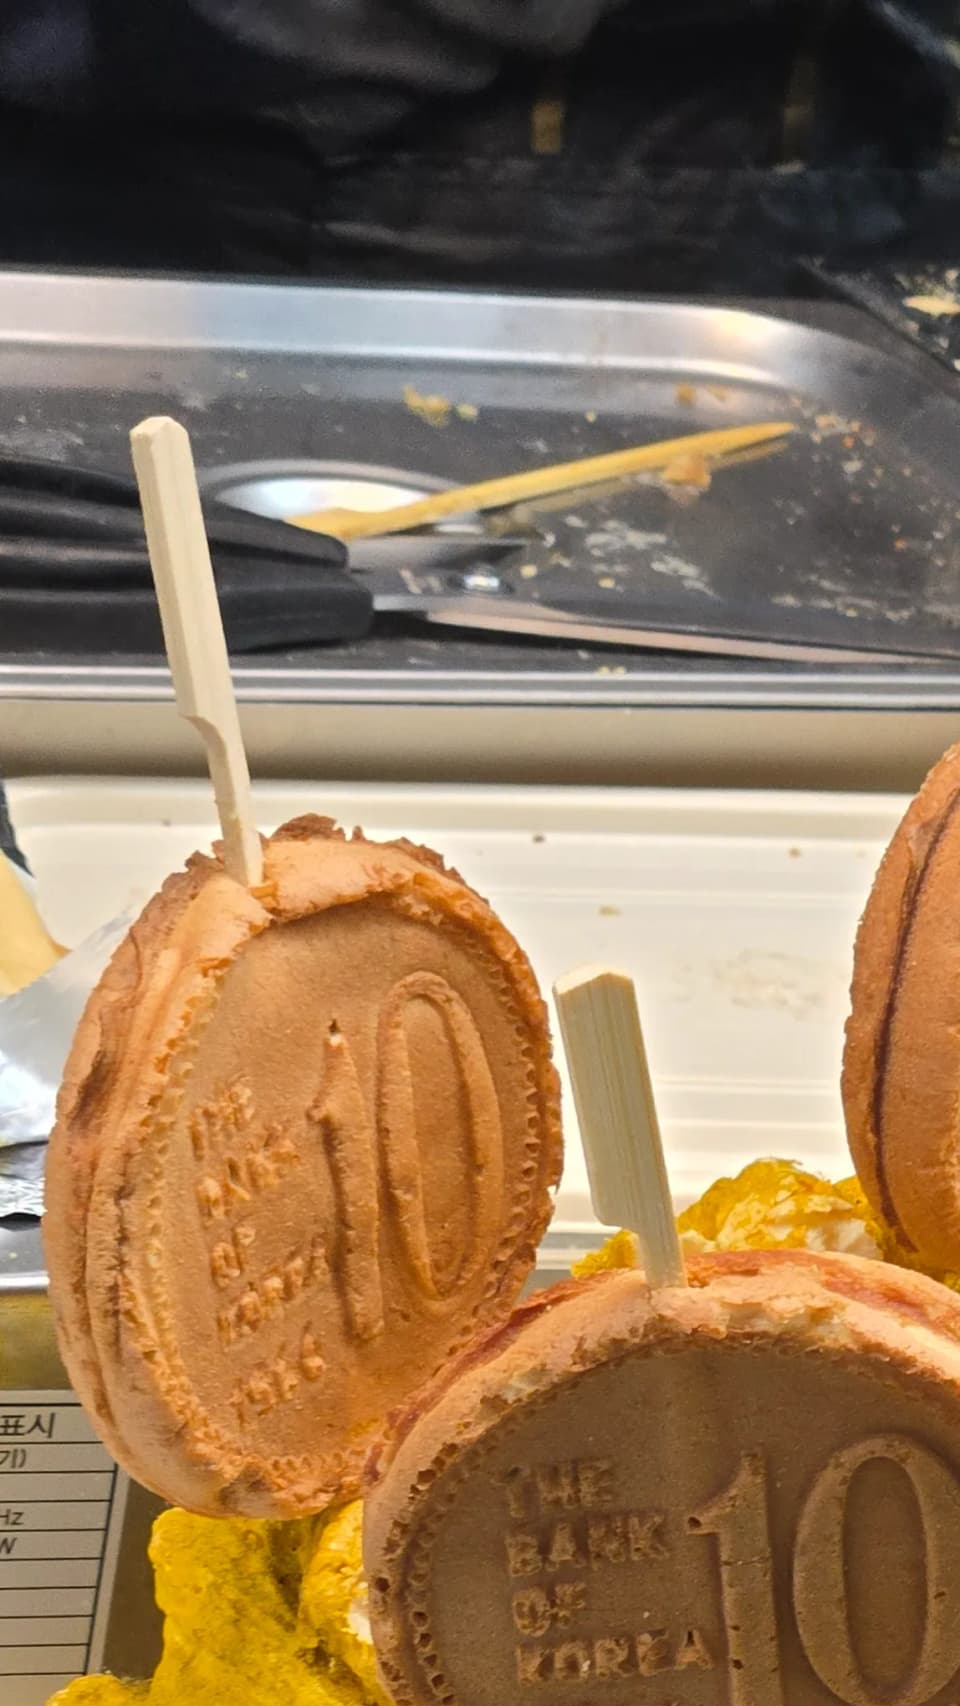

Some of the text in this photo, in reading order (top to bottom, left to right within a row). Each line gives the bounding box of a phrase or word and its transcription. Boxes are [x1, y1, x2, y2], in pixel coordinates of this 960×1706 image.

[306, 970, 500, 1343] 10
[0, 1412, 56, 1439] 표시
[507, 1457, 615, 1517] THE
[507, 1512, 672, 1577] BANK
[513, 1581, 586, 1637] OF
[517, 1628, 714, 1685] KOREA
